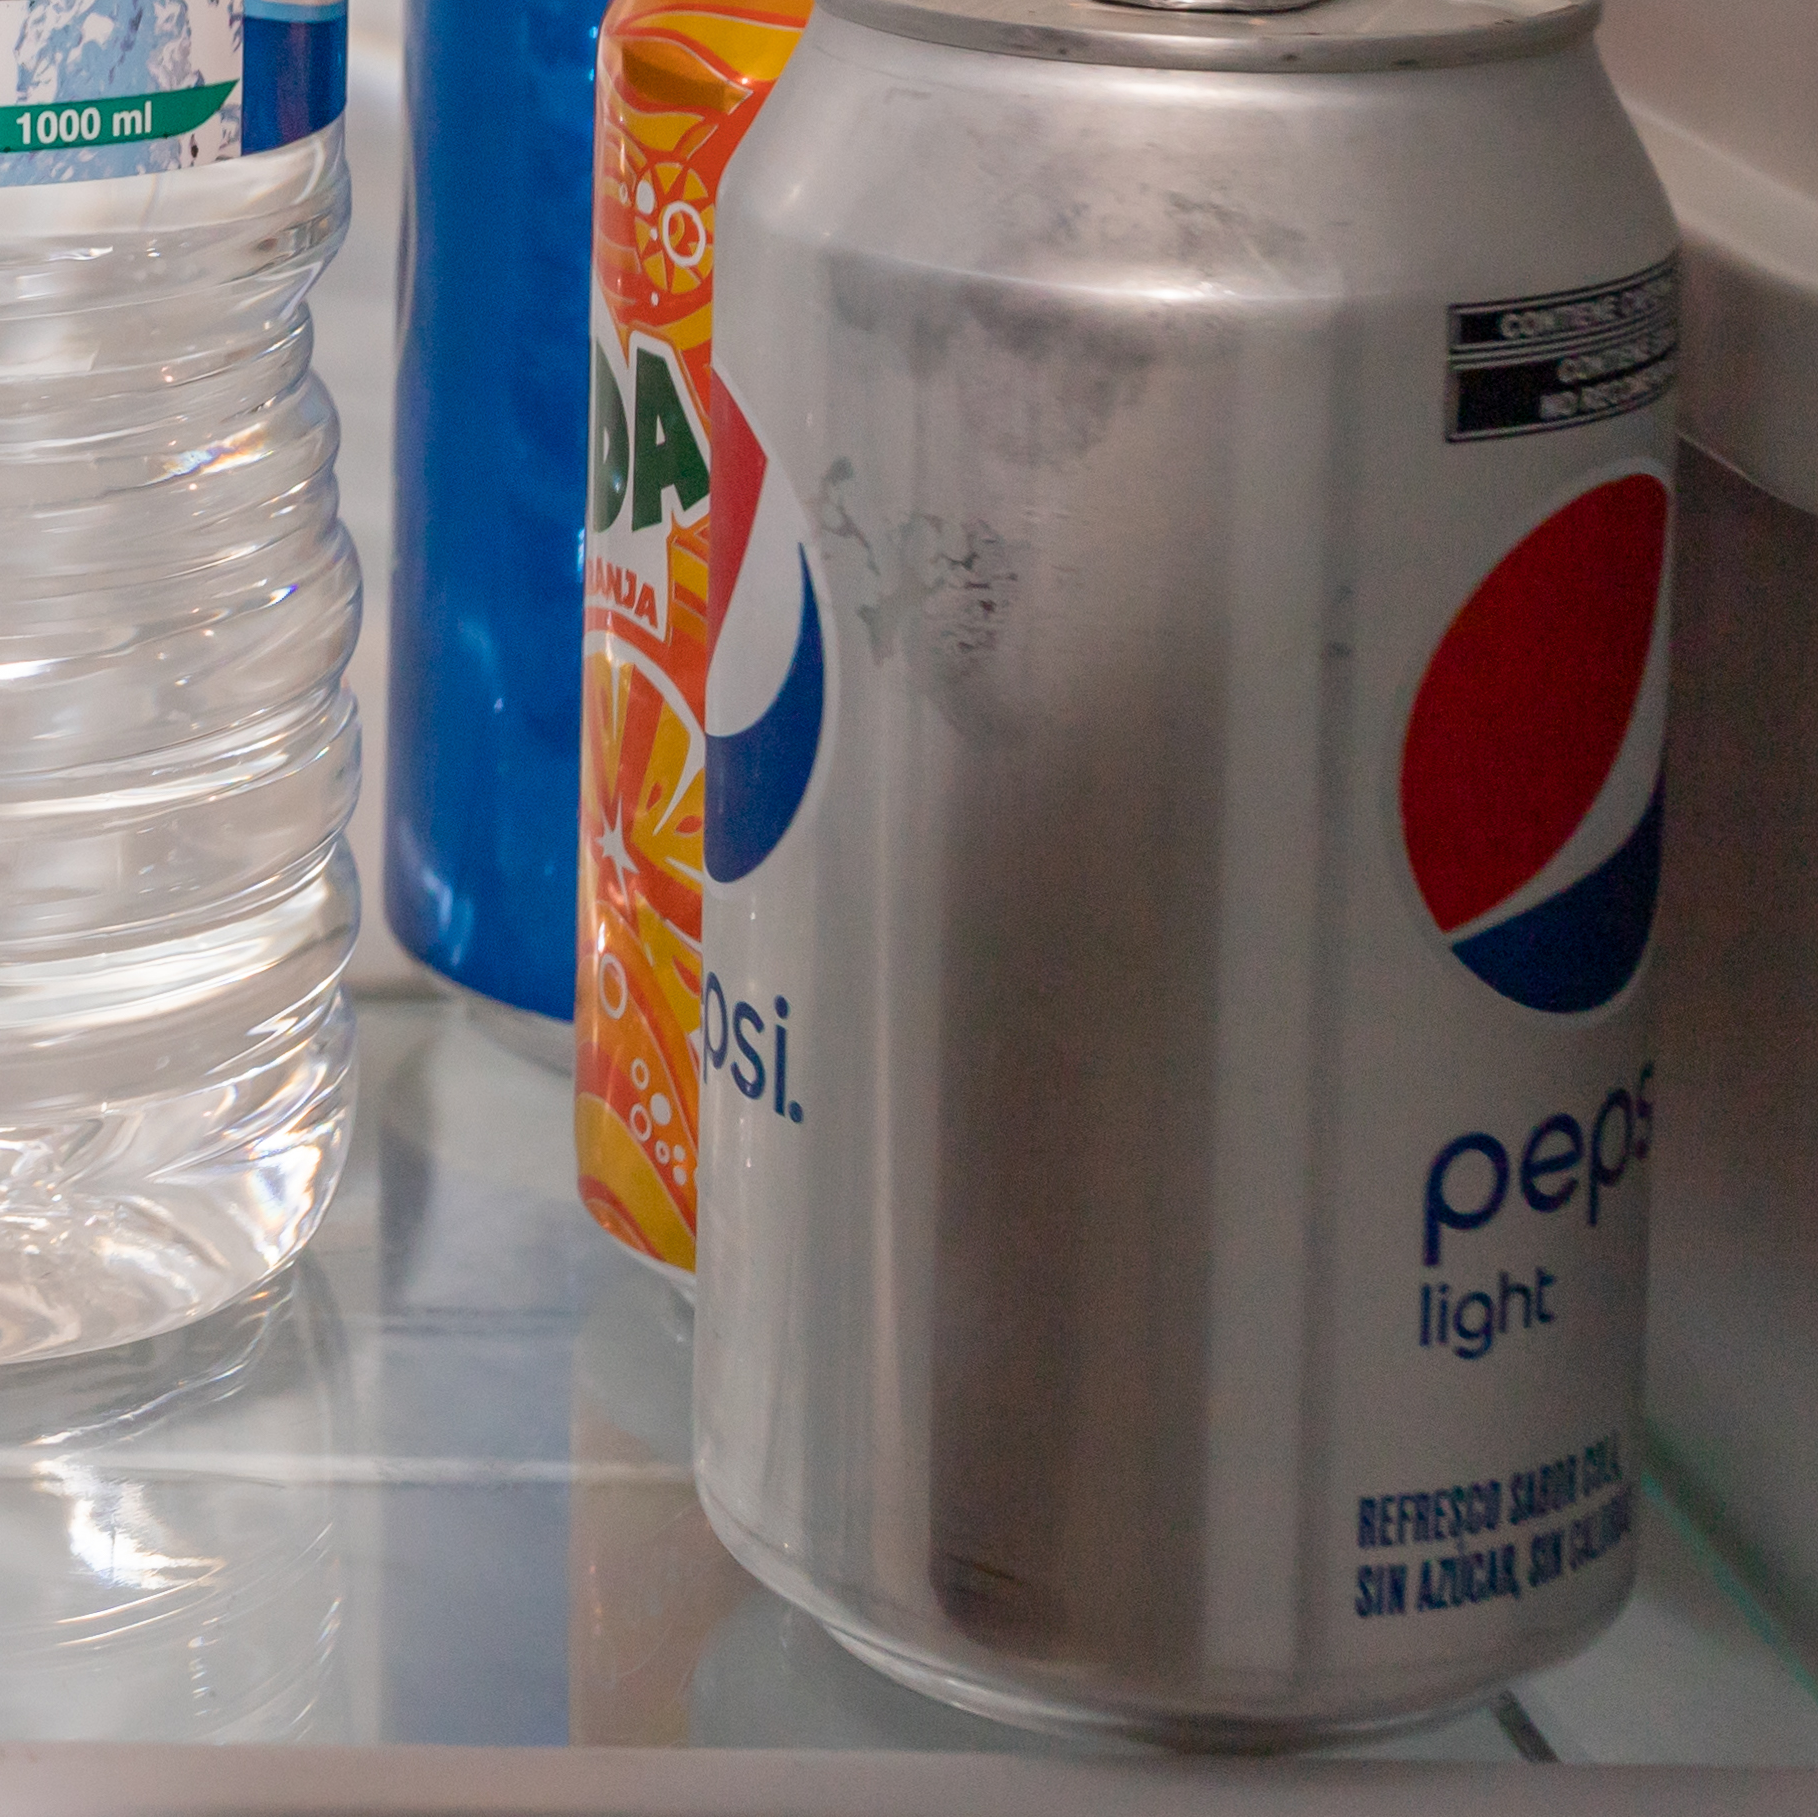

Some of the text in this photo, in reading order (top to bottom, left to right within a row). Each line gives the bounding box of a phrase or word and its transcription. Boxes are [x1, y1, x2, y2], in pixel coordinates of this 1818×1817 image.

[15, 101, 153, 145] 1000 ml
[1419, 1267, 1556, 1360] light
[1358, 1478, 1502, 1549] REFRESCO
[1355, 1564, 1408, 1619] SIN
